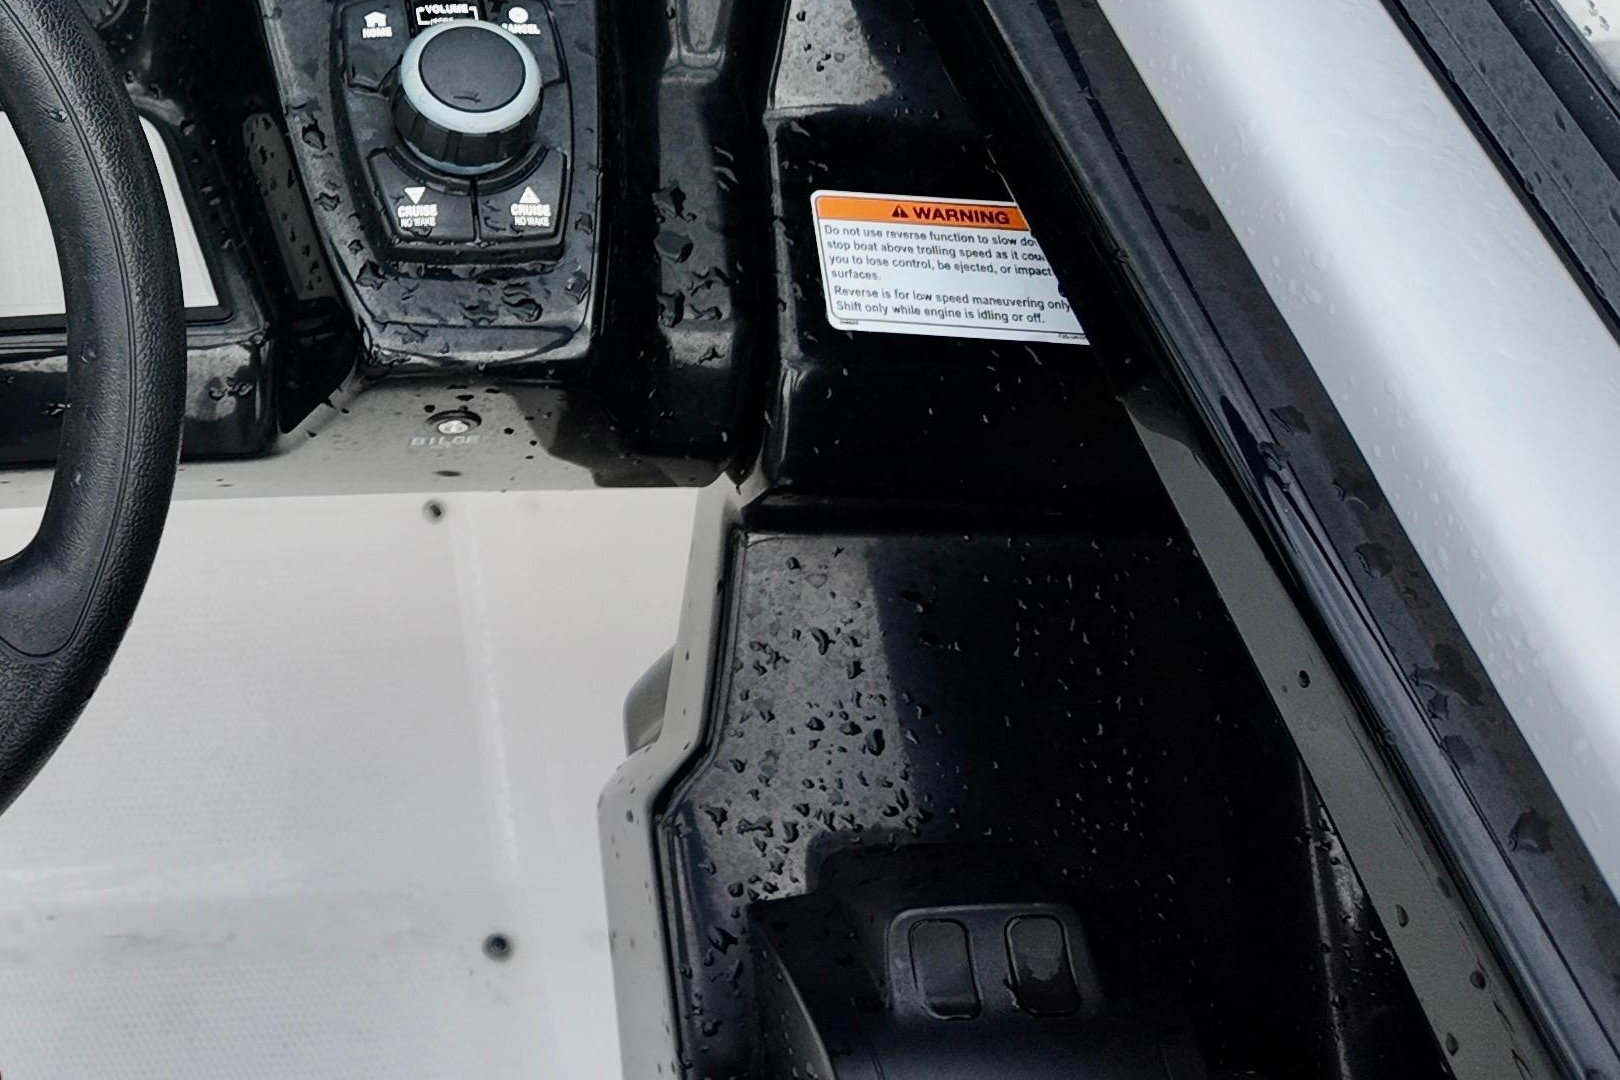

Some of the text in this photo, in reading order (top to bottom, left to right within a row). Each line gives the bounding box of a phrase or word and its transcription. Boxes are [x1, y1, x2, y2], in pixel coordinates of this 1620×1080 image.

[425, 3, 469, 14] VOLUME
[397, 204, 438, 218] CRUISE
[510, 203, 551, 217] CRUISE
[912, 207, 1010, 224] WARNING
[824, 225, 840, 235] Do
[842, 226, 860, 236] not
[863, 228, 883, 238] use
[886, 230, 927, 240] reverse
[930, 231, 975, 243] function
[978, 234, 989, 244] to
[992, 235, 1017, 245] slow
[827, 240, 1045, 262] stop boat above trolling speed as it cou
[829, 255, 1052, 277] you to lose control, be ejected, or impact
[831, 269, 882, 280] surfaces.
[834, 285, 878, 298] Reverse
[881, 287, 891, 299] is
[894, 288, 910, 300] for
[913, 290, 932, 301] low
[936, 293, 969, 305] speed
[972, 297, 1045, 311] maneuvering
[836, 301, 1045, 323] Shift only while engine is idling or off.
